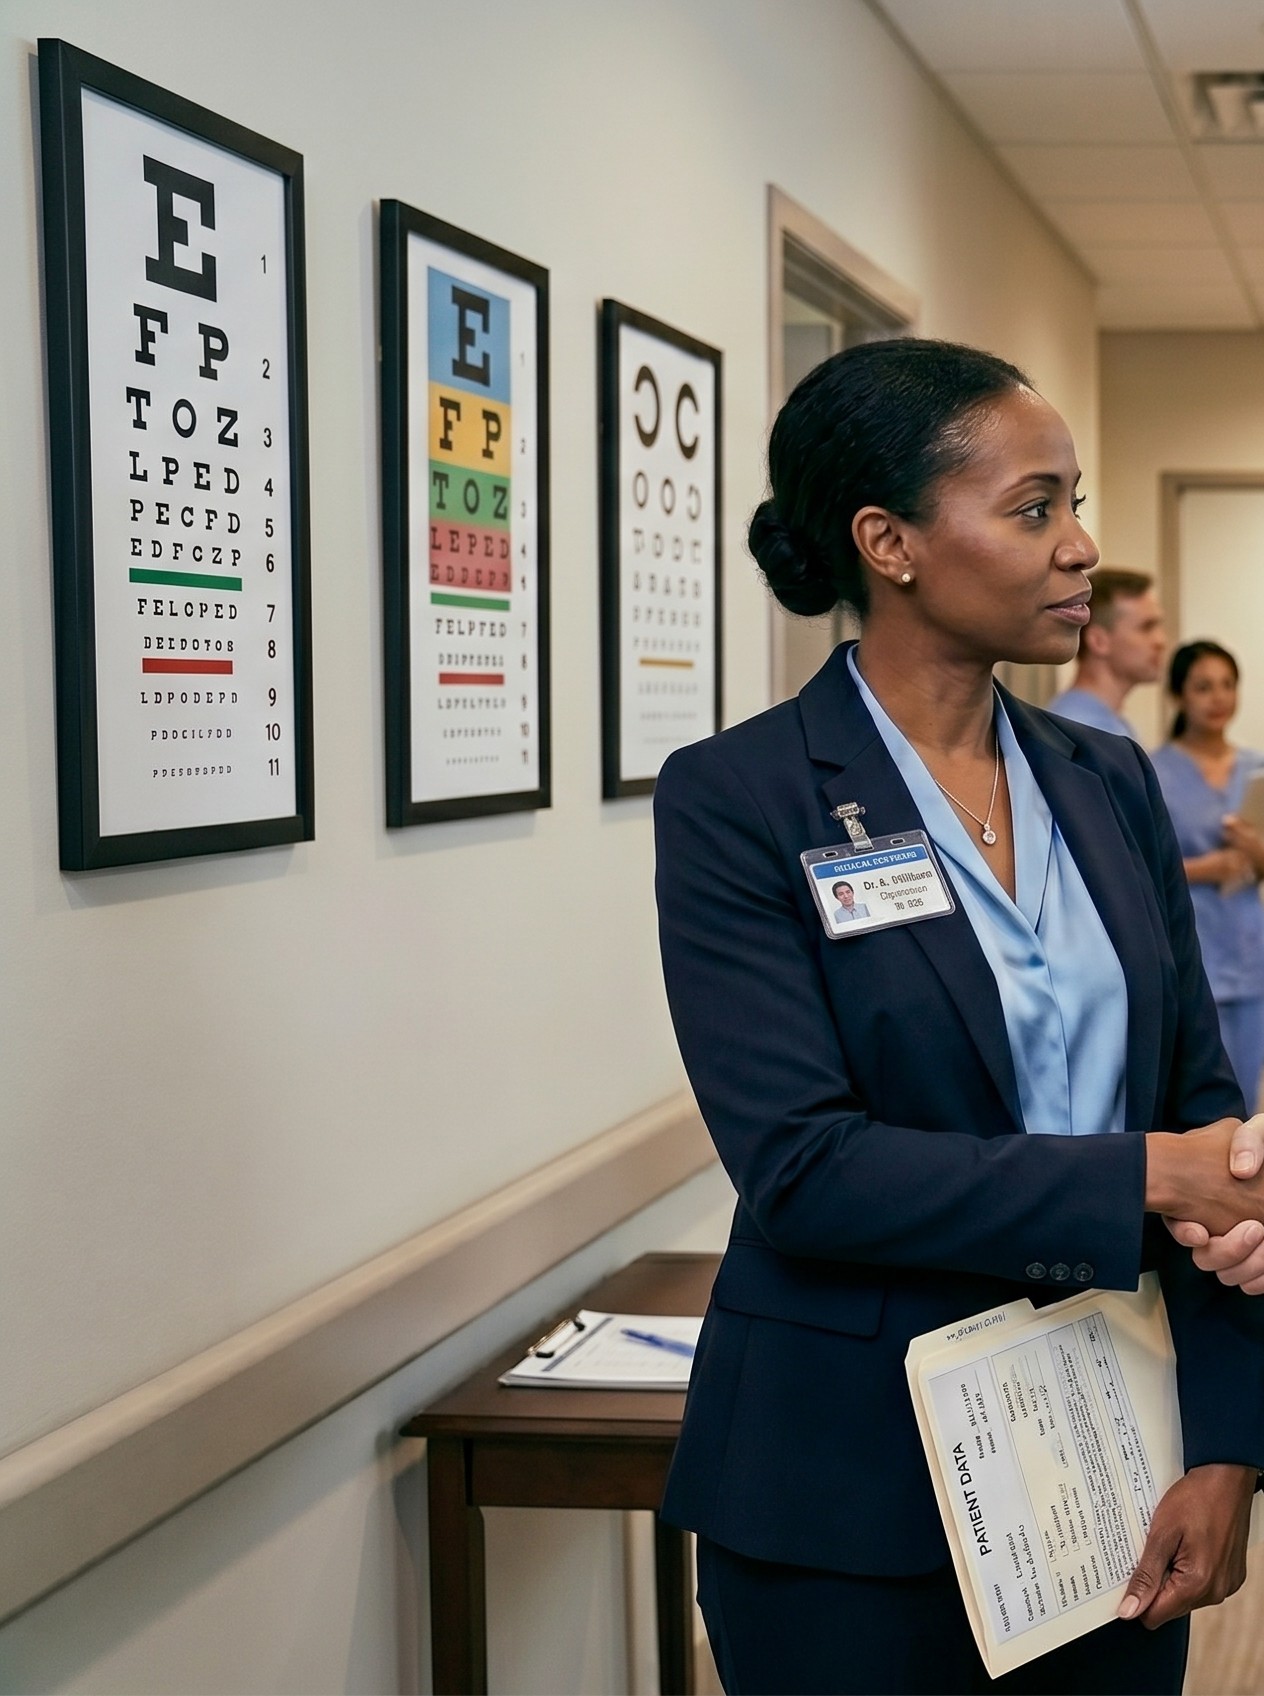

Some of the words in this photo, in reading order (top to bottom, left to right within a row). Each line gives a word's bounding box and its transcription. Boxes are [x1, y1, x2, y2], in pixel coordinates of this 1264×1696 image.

[143, 154, 217, 303] E
[260, 254, 266, 274] 1
[452, 285, 490, 388] E
[262, 358, 270, 380] 2
[263, 427, 272, 448] 3
[264, 478, 274, 497] 4
[265, 518, 274, 537] 5
[266, 553, 274, 573] 6
[267, 604, 275, 622] 7
[268, 640, 276, 658] 8
[268, 688, 277, 706] 9
[265, 723, 281, 741] 10
[268, 758, 280, 776] 11
[953, 1442, 973, 1486] DATA
[964, 1490, 993, 1556] PATIENT
